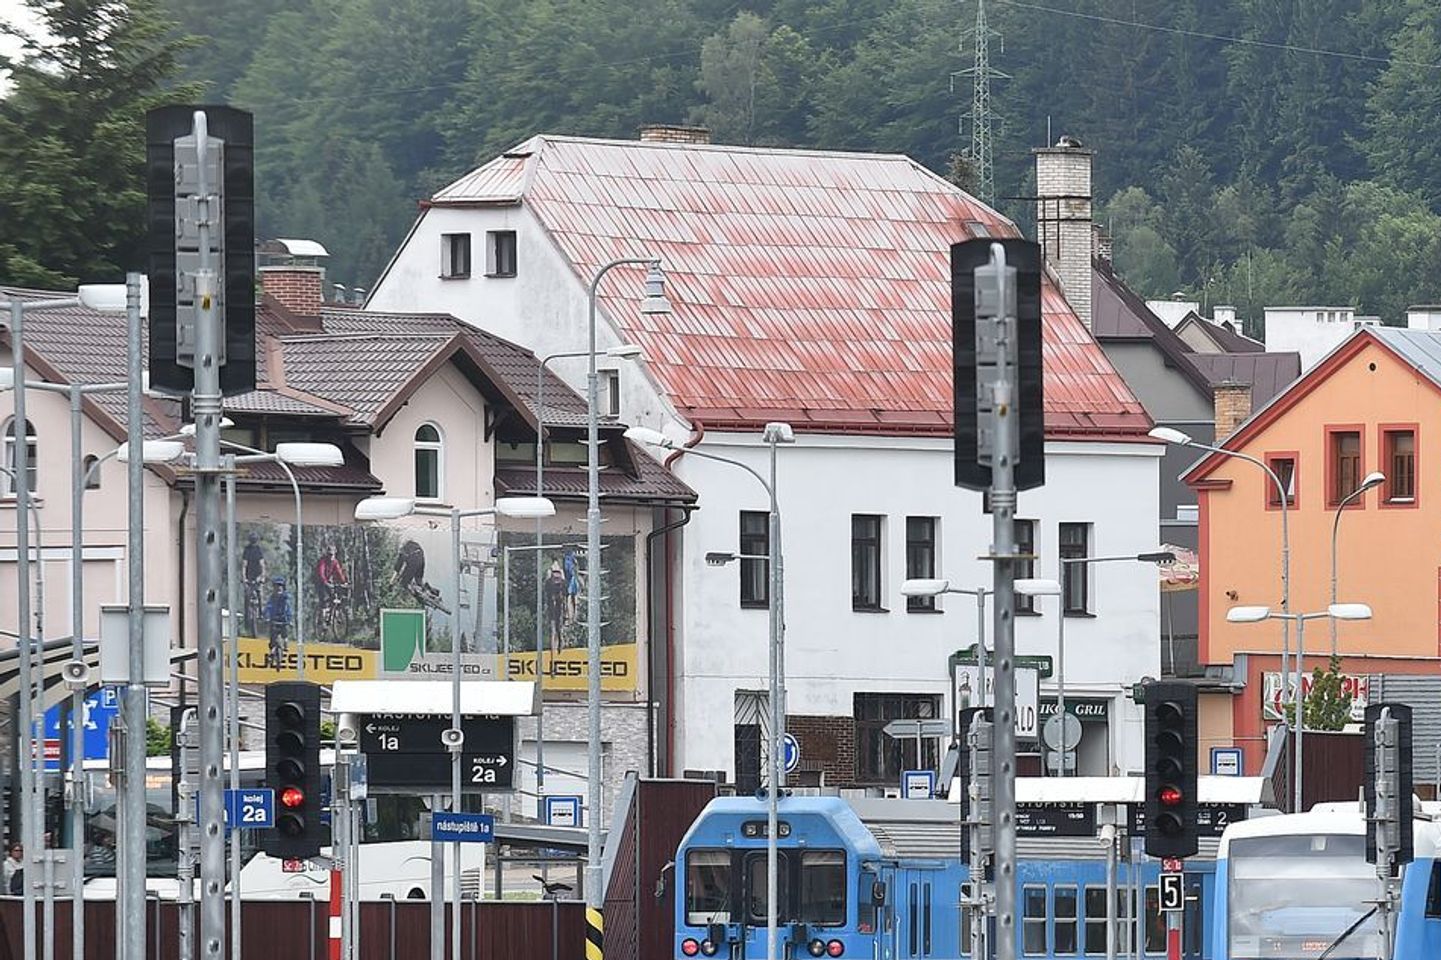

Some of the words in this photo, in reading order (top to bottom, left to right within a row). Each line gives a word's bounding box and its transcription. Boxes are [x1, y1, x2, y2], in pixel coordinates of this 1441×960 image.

[225, 652, 363, 671] KIJESTED
[1075, 703, 1105, 716] GRIL
[378, 733, 399, 751] 1a
[471, 765, 496, 783] 2a
[242, 805, 267, 822] 2a
[1164, 877, 1178, 903] 5
